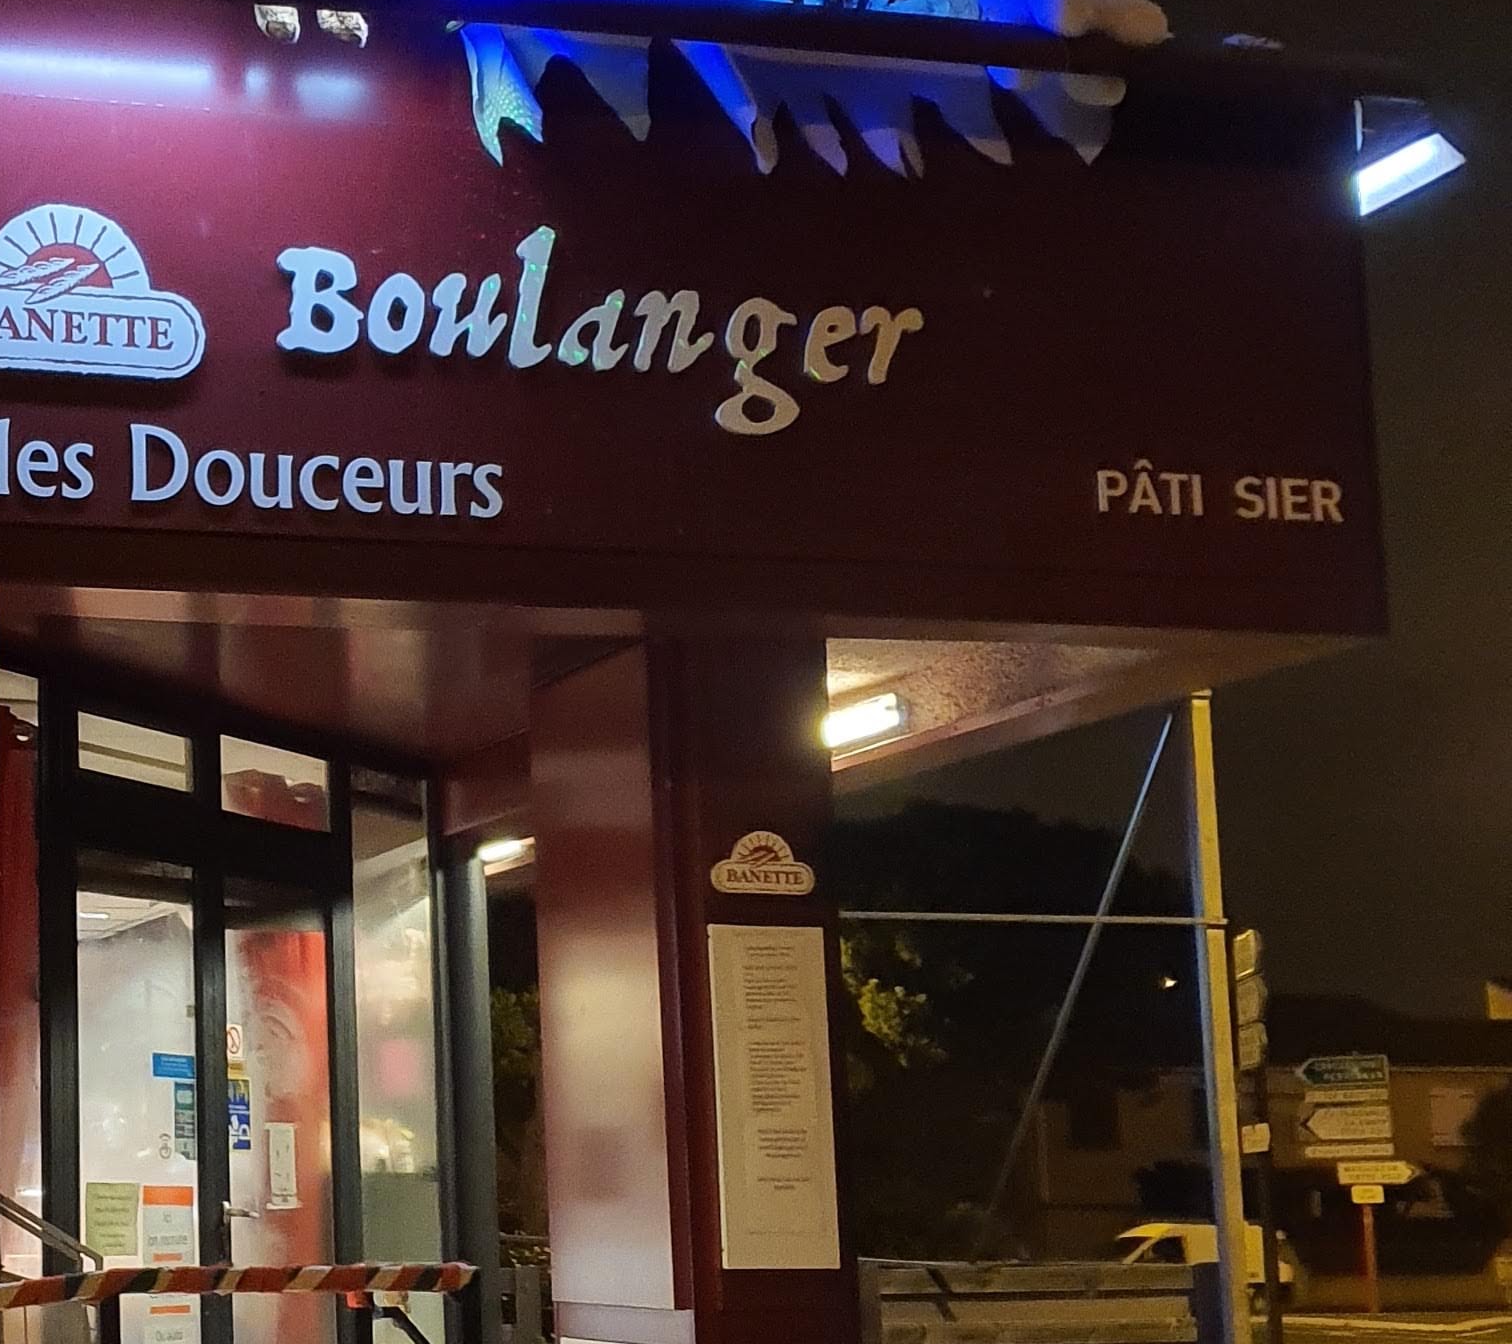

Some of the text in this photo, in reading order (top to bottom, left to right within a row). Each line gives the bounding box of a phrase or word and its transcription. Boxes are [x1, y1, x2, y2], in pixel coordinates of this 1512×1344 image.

[276, 226, 923, 434] Boulanger
[129, 422, 504, 518] Douceurs
[726, 868, 804, 885] BANETTE
